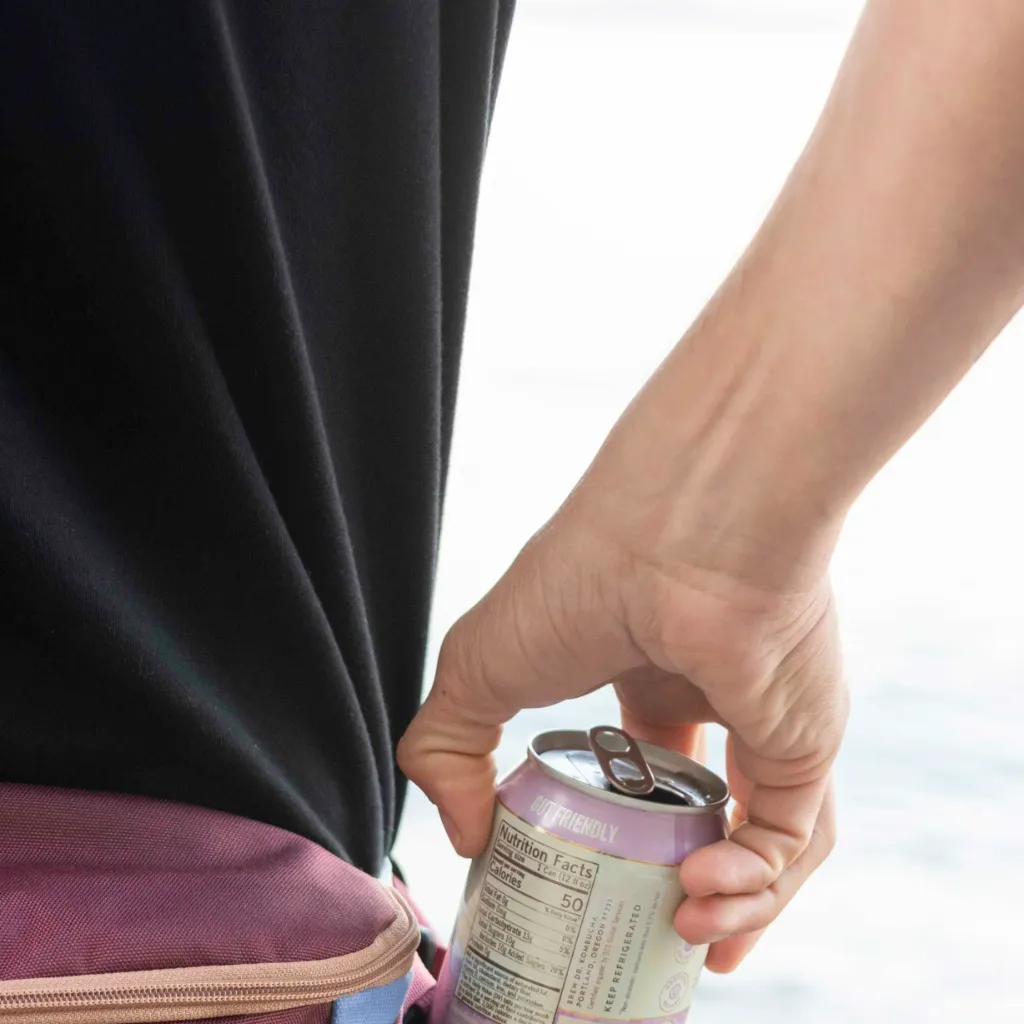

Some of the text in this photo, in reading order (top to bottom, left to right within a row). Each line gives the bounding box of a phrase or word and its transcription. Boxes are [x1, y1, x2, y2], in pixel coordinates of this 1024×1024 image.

[530, 794, 619, 843] GUT FRIENDLY
[496, 839, 514, 858] Serving
[514, 852, 526, 863] size
[537, 864, 542, 872] 1
[543, 866, 557, 877] Can
[558, 869, 571, 883] (12
[579, 880, 592, 891] oz)
[499, 824, 593, 879] Nutrition Facts
[489, 861, 584, 912] Calories 50
[487, 912, 522, 937] Carbohydrate
[559, 945, 571, 956] 5%
[493, 890, 501, 902] Fat
[565, 924, 577, 934] 0%
[551, 908, 564, 919] Daily
[505, 934, 517, 949] 10g
[507, 948, 525, 962] Added
[566, 916, 598, 1005] BREW DR. KOMBUCHA
[576, 961, 597, 1008] PORTLAND,
[591, 922, 605, 959] OREGON
[604, 904, 642, 1013] KEEP REFRIGERATED
